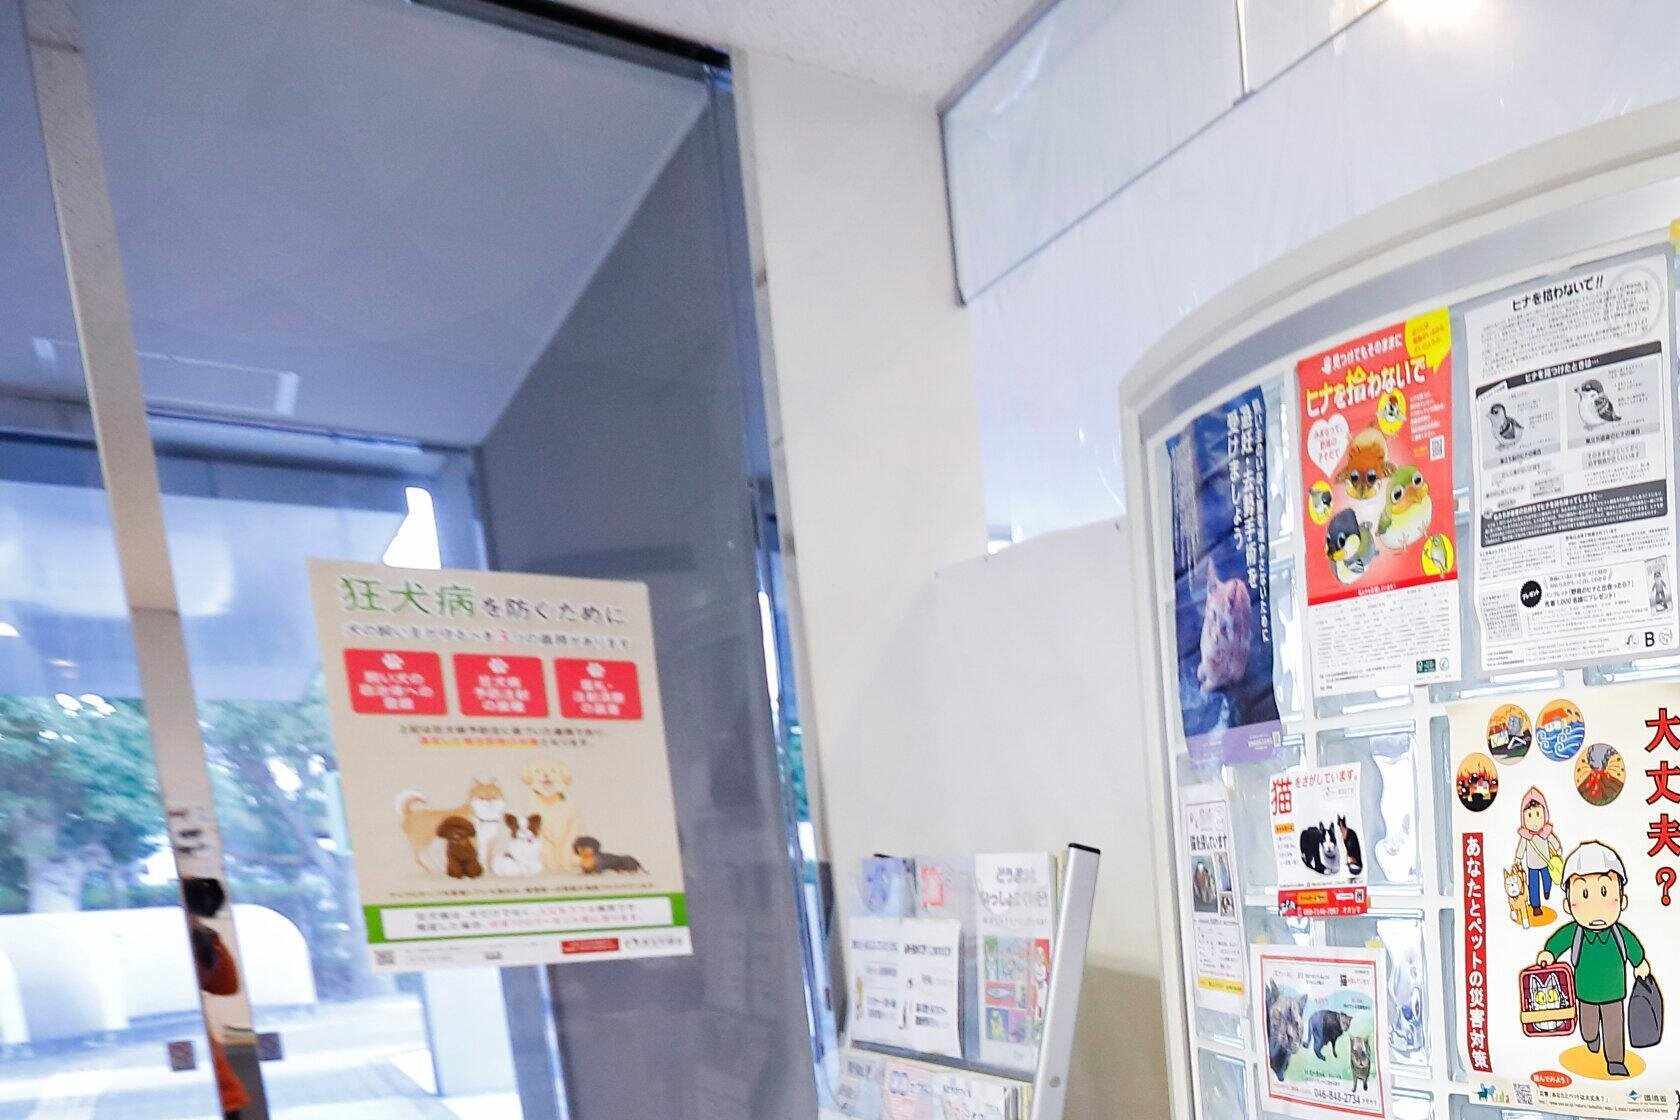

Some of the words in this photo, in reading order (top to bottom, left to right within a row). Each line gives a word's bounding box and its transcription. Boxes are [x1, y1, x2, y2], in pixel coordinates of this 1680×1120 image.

[1465, 836, 1489, 1070] あなたとペットの災害対策
